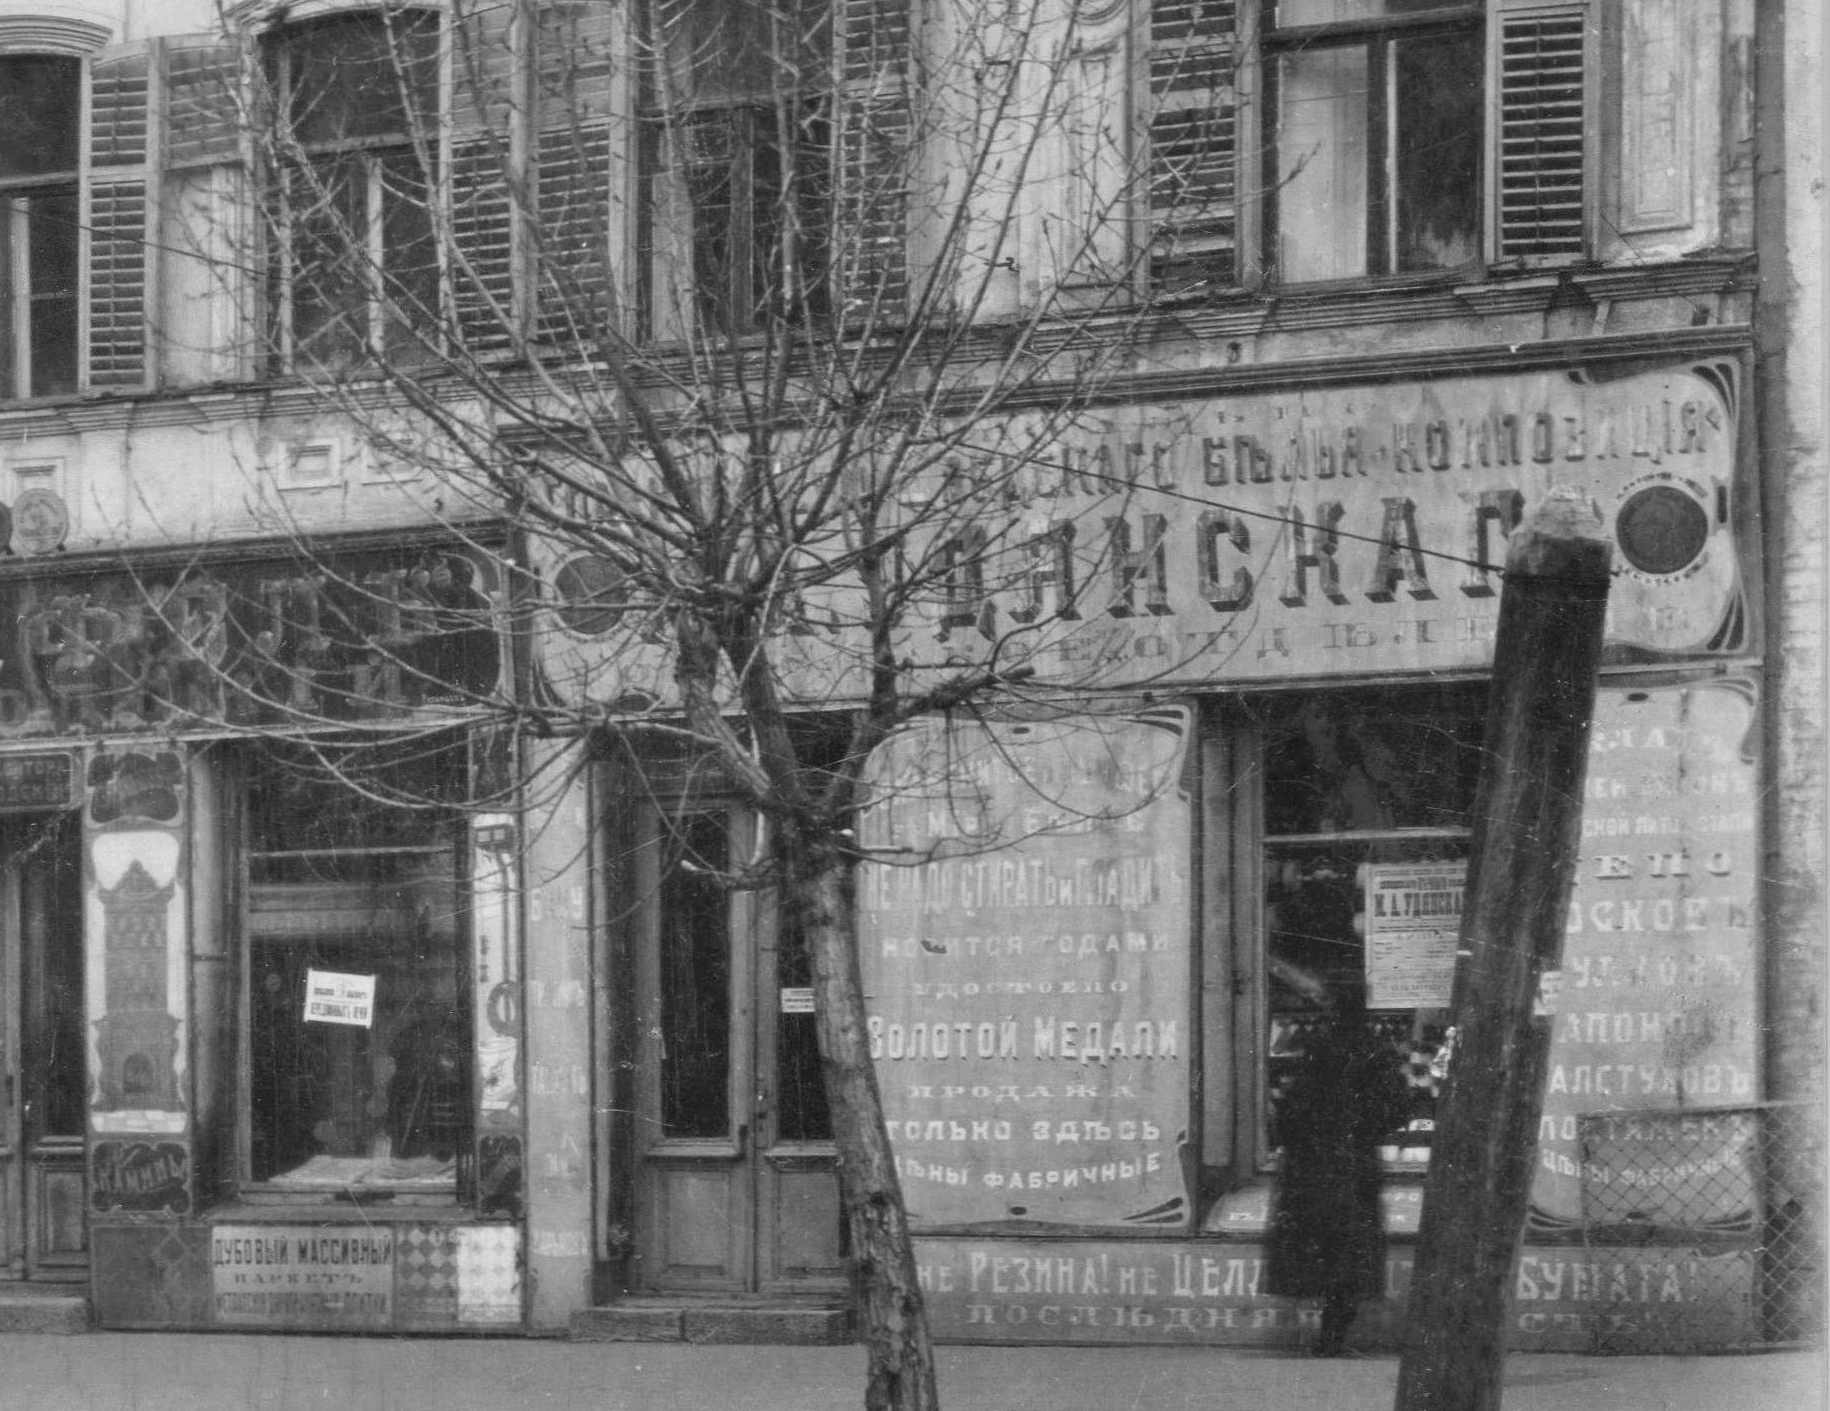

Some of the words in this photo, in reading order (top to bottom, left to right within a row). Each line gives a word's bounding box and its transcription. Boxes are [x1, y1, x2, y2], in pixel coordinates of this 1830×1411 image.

[867, 1014, 1018, 1060] ЗОЛОТОЙ
[1034, 1016, 1178, 1068] МЕДАЛИ
[908, 1085, 1137, 1104] ПРОДАЖА
[886, 1120, 1012, 1142] ТОЛЬКО
[1032, 1120, 1161, 1145] ЗДѢСЬ
[894, 1154, 969, 1186] ѢНЫ
[984, 1152, 1161, 1189] ФАБРИЧНЫЕ
[969, 1251, 1110, 1294] РЕЗИНА!
